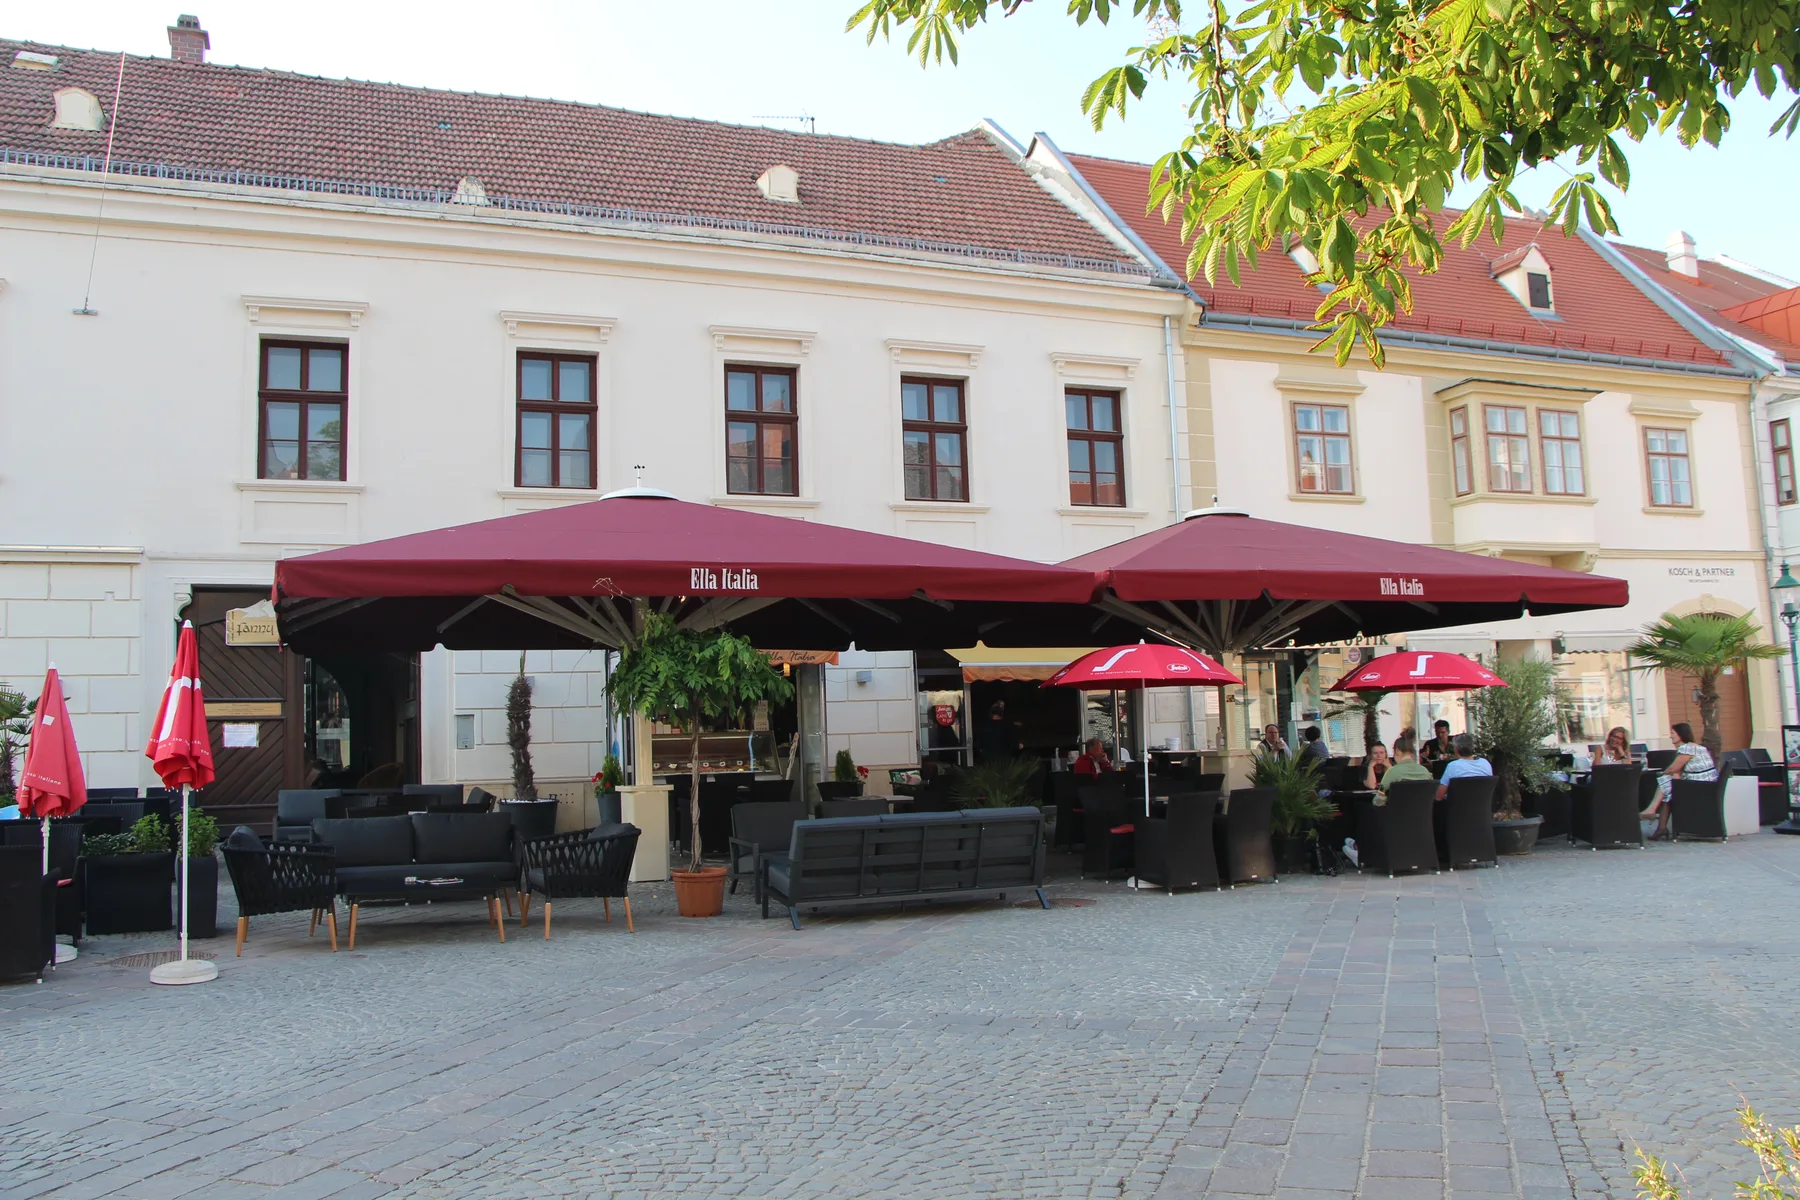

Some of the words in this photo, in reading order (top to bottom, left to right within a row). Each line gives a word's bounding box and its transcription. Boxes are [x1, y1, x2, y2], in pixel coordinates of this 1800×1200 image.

[691, 568, 718, 590] Ella
[722, 568, 759, 590] Italia
[1668, 568, 1693, 576] KOSCH
[1695, 568, 1701, 577] &
[1702, 568, 1735, 576] PARTNER
[1380, 578, 1399, 595] Ella
[1400, 578, 1424, 596] Italia
[38, 774, 62, 785] italiano
